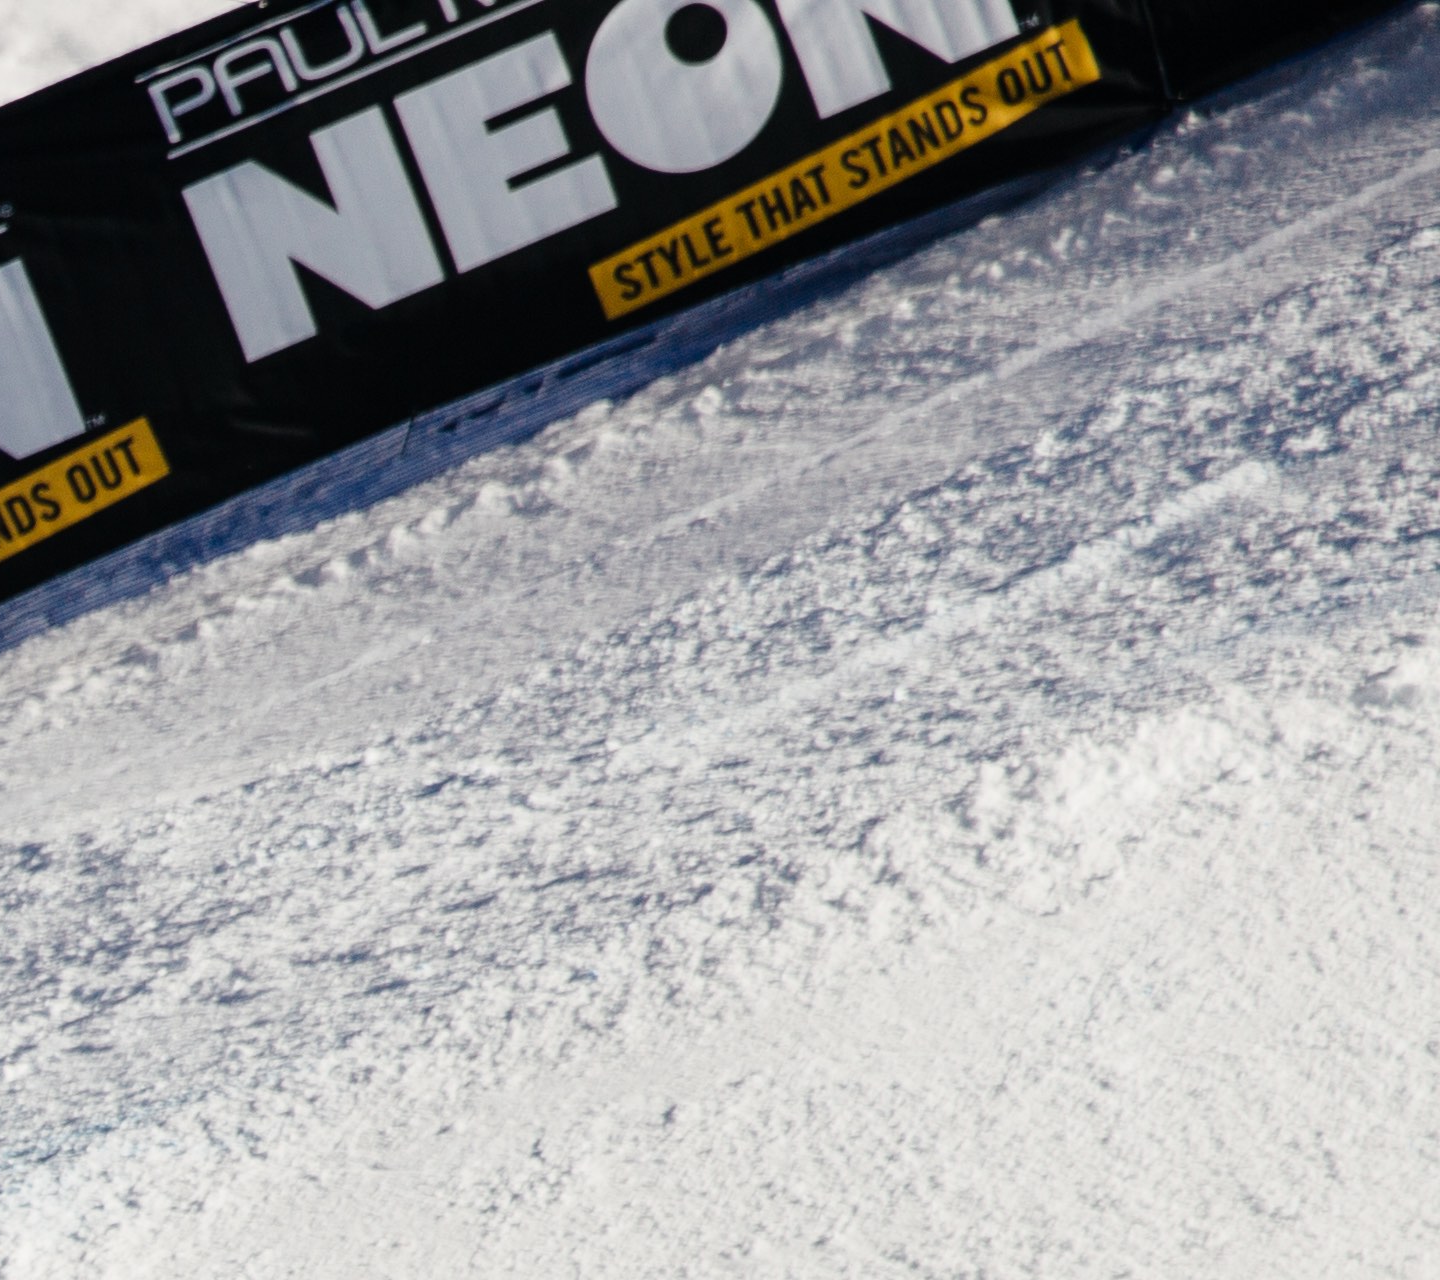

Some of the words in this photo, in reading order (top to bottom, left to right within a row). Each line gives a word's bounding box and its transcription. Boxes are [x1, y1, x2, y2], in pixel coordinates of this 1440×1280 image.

[148, 0, 429, 144] PAUL
[612, 215, 733, 301] STYLE
[735, 164, 833, 241] THAT
[840, 86, 990, 190] STANDS
[997, 38, 1075, 106] OUT
[65, 435, 144, 505] OUT
